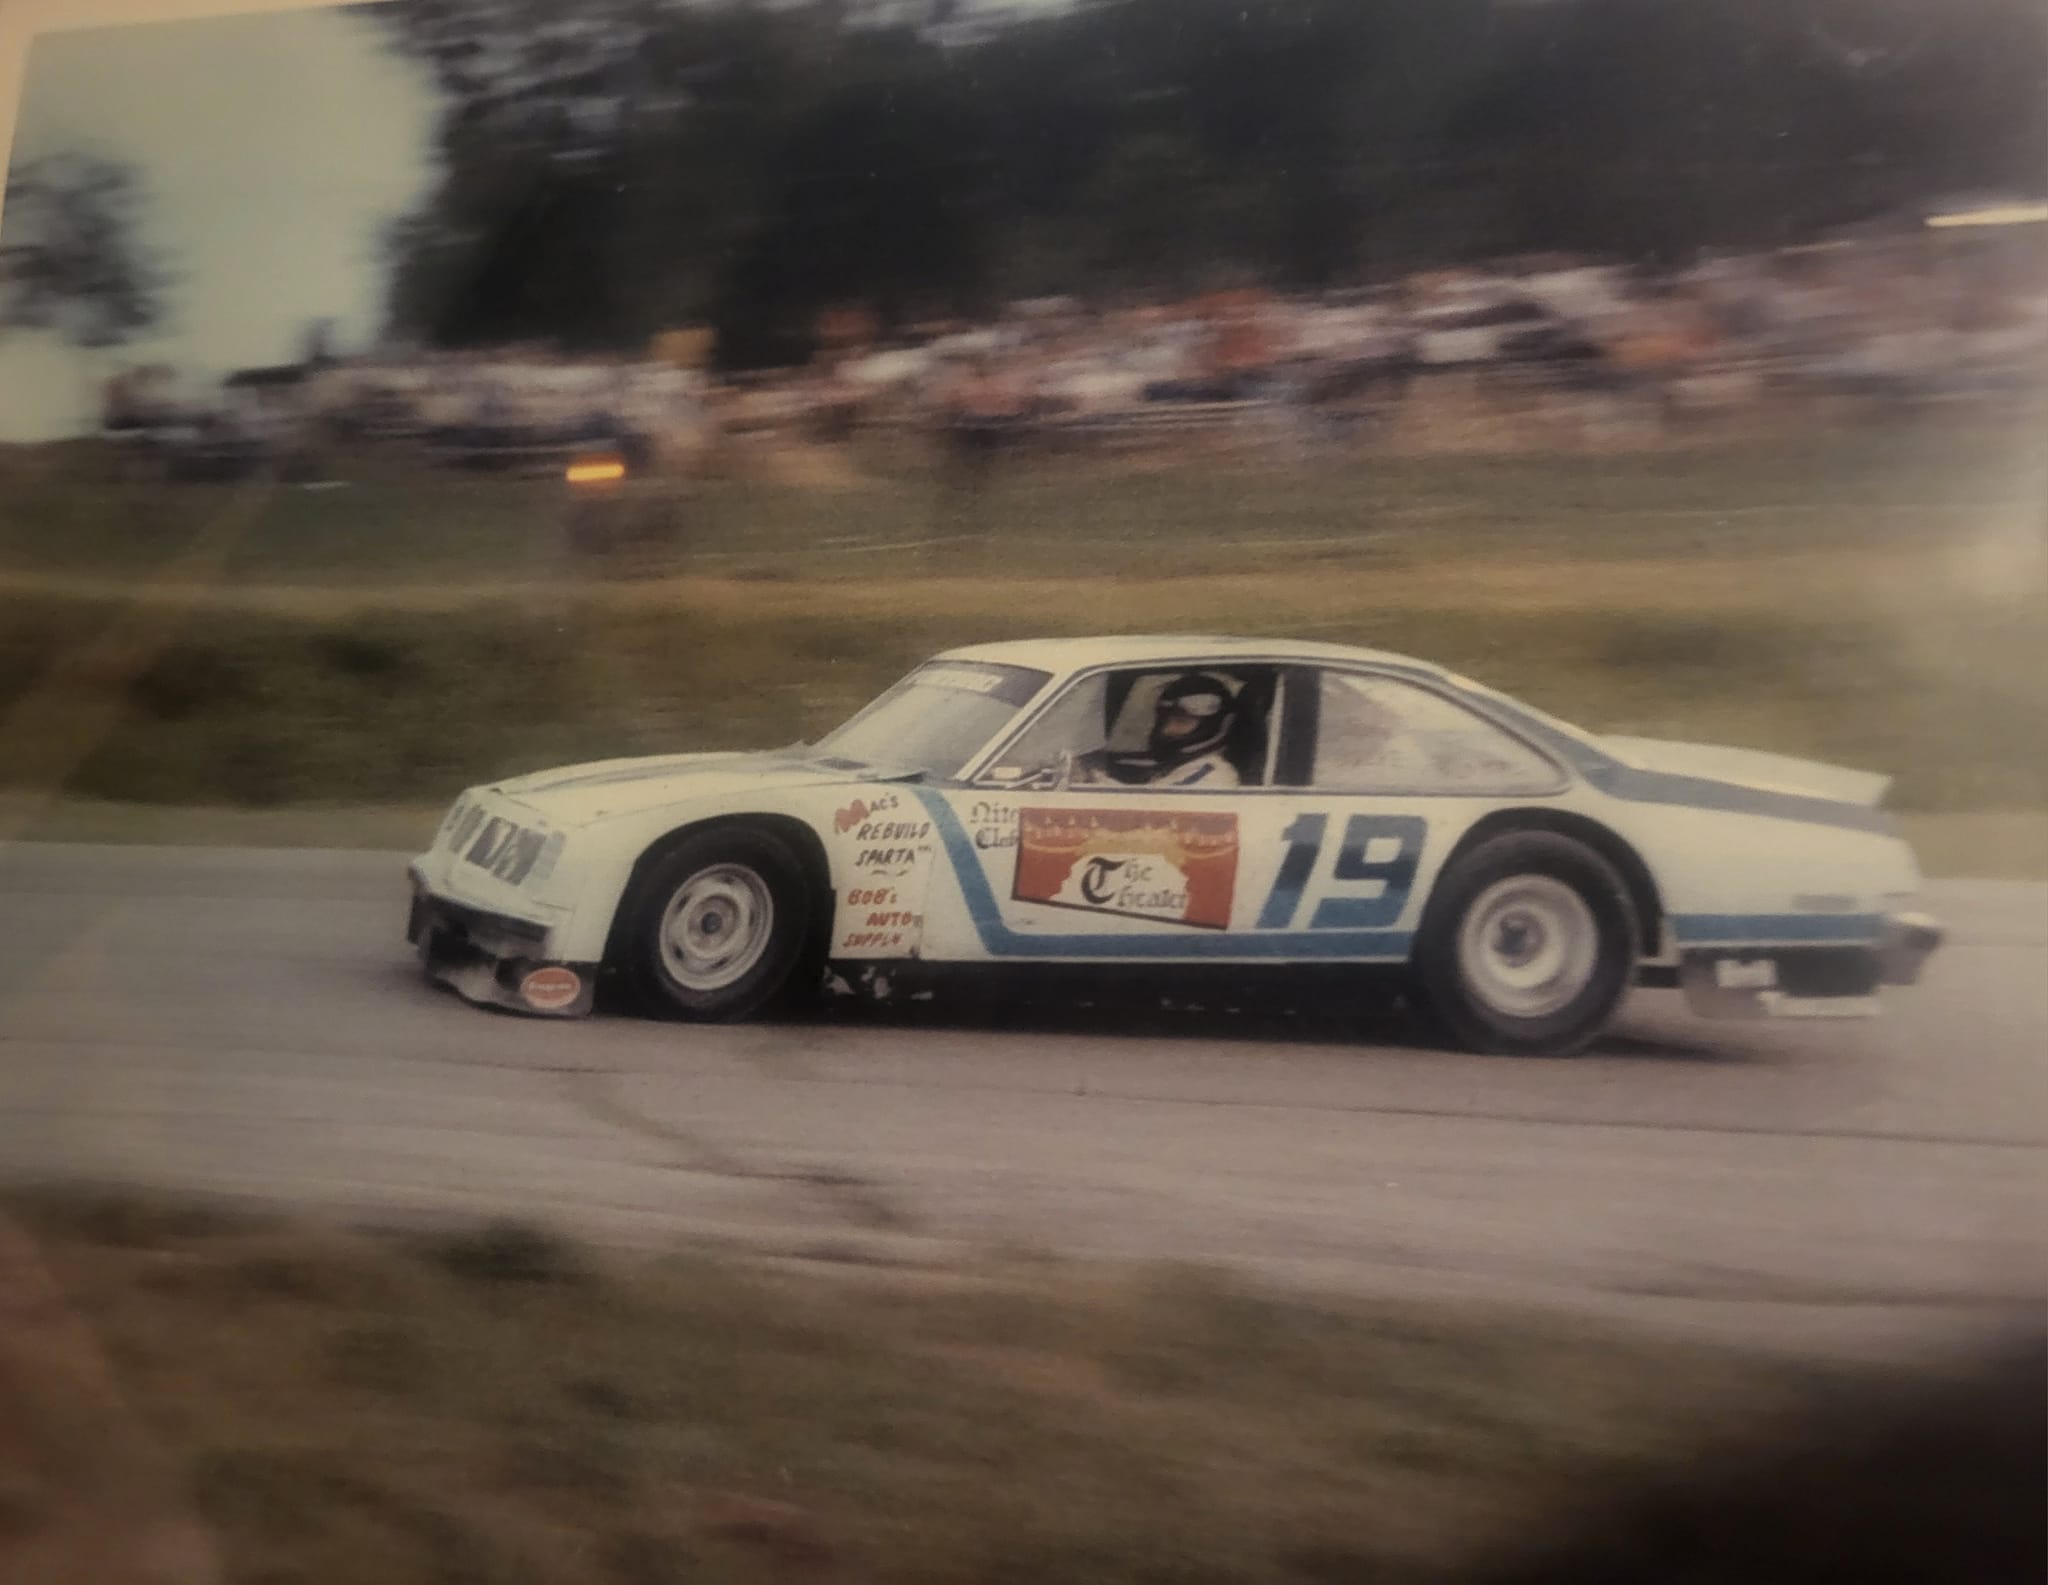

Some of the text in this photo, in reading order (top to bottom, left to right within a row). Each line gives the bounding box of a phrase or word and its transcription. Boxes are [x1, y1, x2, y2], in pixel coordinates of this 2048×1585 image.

[856, 822, 930, 840] REBUILD
[854, 848, 916, 867] SPARTA
[1254, 813, 1428, 929] 19
[866, 911, 912, 927] AUTO
[842, 933, 902, 948] SUPPLY
